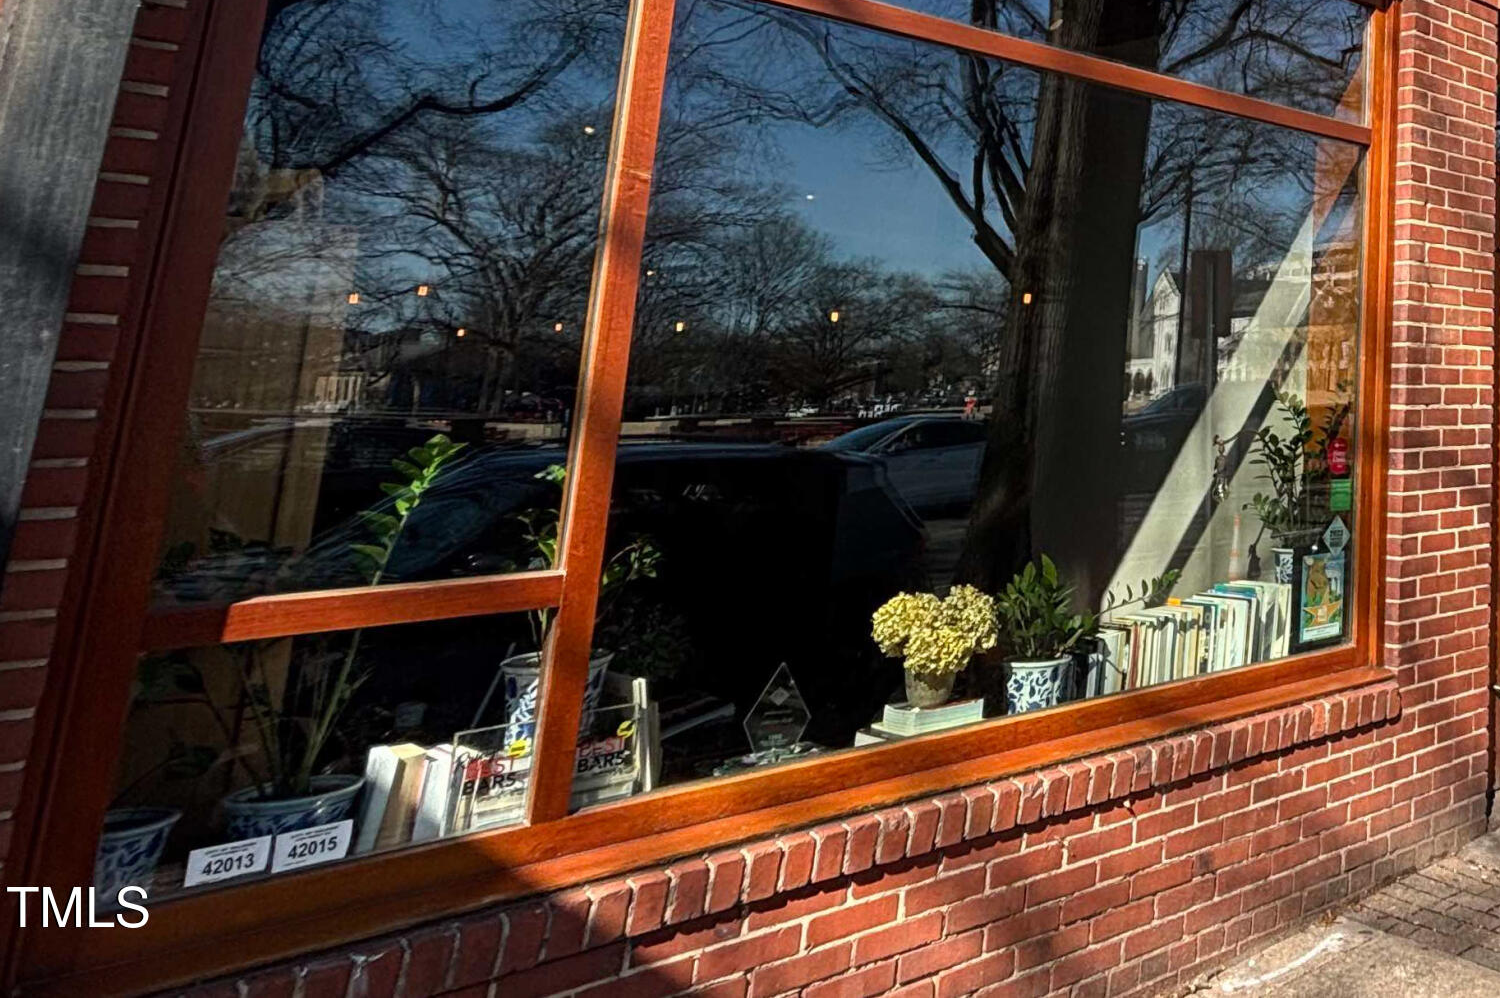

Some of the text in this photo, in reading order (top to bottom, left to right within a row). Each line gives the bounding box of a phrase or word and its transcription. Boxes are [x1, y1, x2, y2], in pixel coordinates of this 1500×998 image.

[577, 751, 625, 773] BARS
[462, 774, 516, 796] BARS
[287, 836, 338, 860] 42015
[202, 853, 255, 876] 42013
